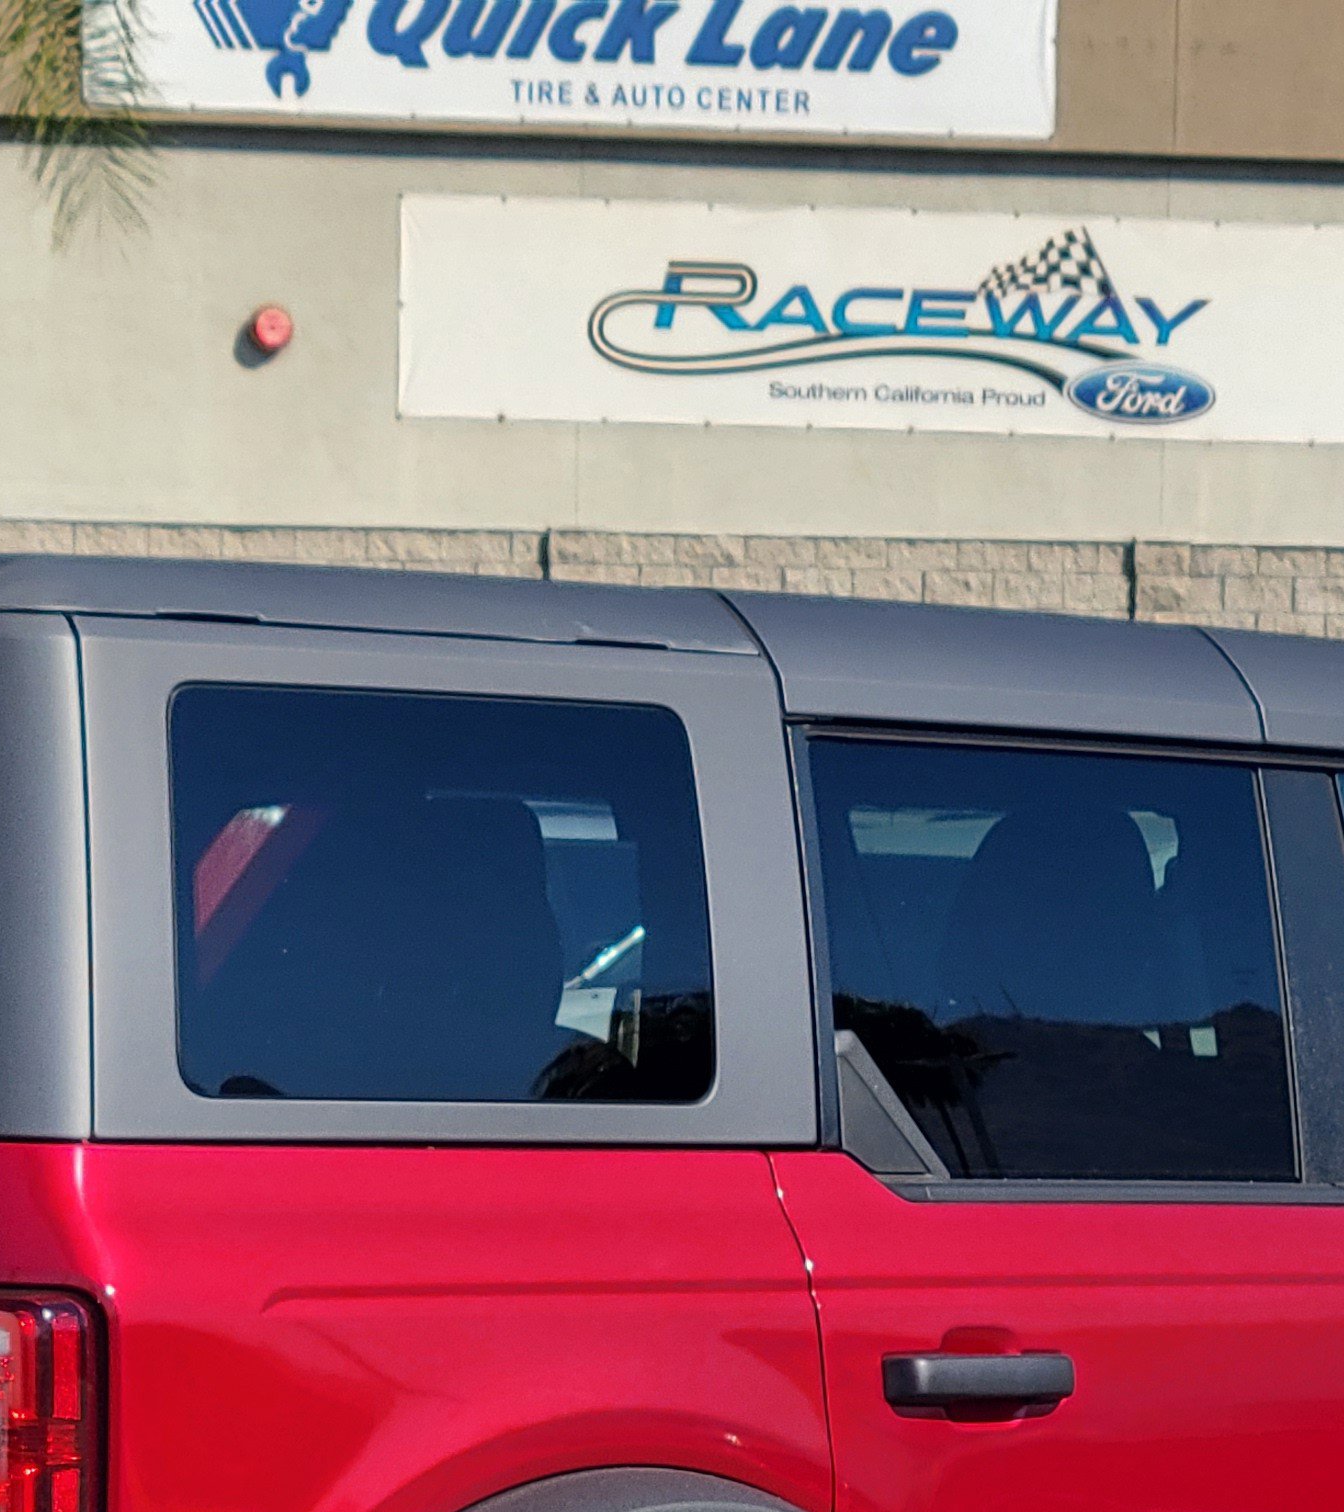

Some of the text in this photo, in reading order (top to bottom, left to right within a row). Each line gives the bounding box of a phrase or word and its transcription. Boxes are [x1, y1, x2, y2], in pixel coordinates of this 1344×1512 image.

[366, 0, 959, 77] Quick Lane
[511, 79, 811, 114] TIRE & AUTO CENTER
[653, 261, 1211, 346] RACEWAY
[769, 380, 1047, 408] Southern California Proud
[1093, 363, 1186, 418] Ford
